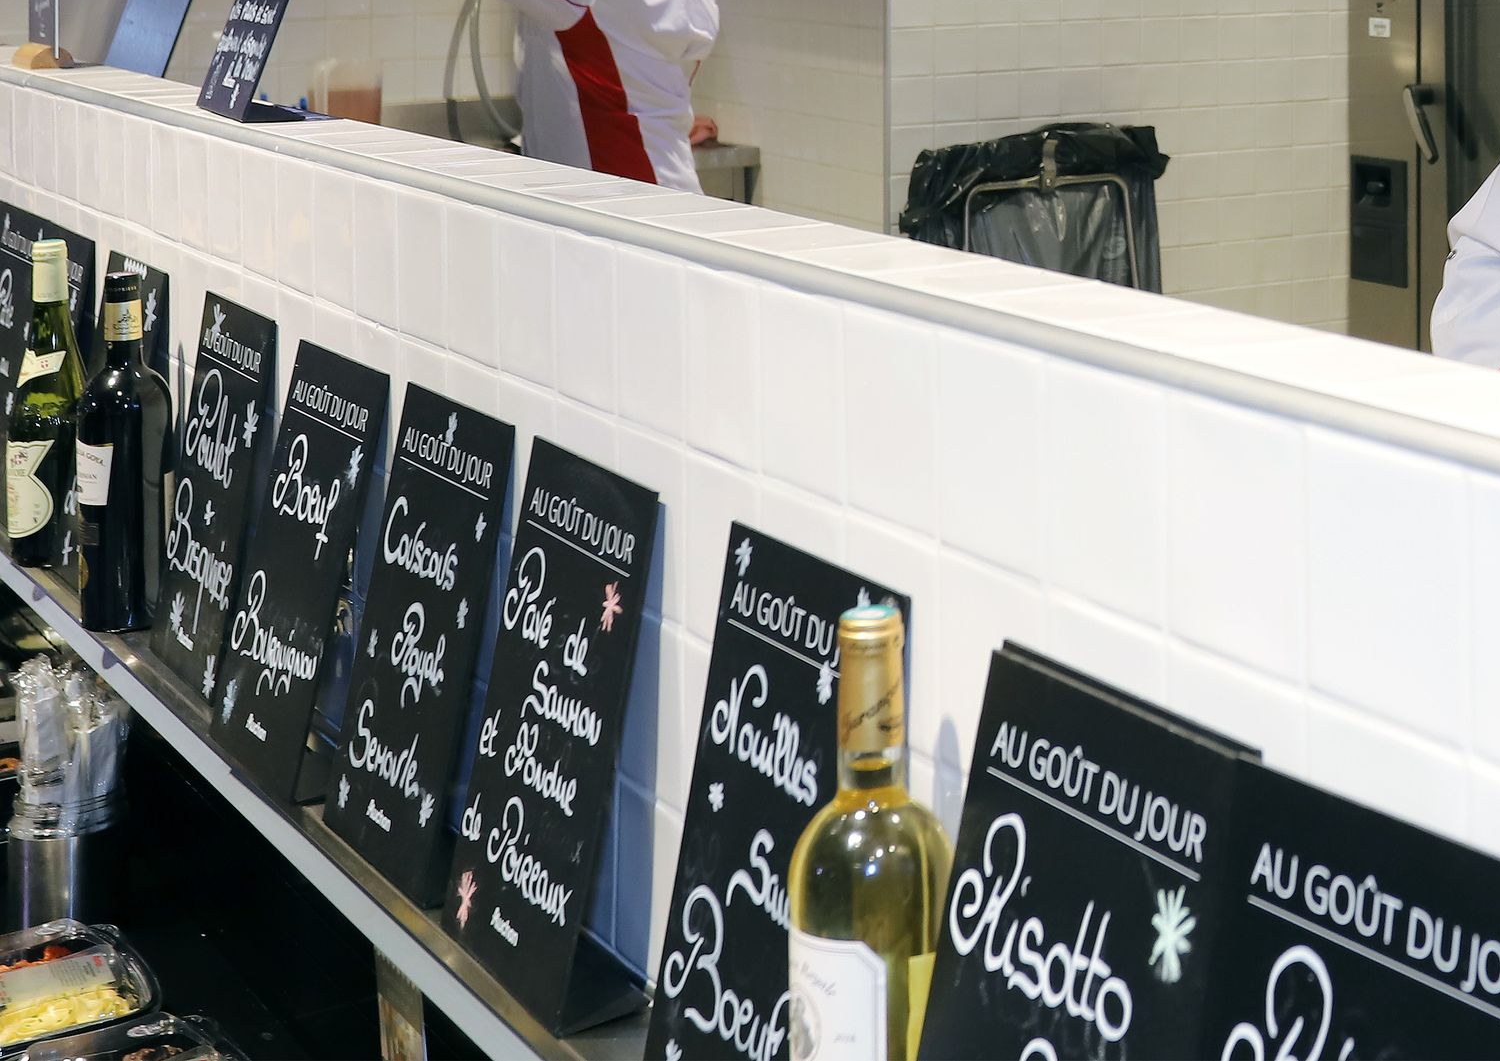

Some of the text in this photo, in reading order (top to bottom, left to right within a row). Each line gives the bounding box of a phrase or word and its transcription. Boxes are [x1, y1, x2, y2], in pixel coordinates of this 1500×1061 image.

[213, 331, 234, 359] GOÛT
[231, 341, 245, 365] DU
[240, 346, 262, 374] JOUR
[185, 368, 238, 490] Poulet
[292, 379, 369, 433] AU GOÛT DU JOUR
[402, 426, 494, 489] AU GOÛT DU JOUR
[383, 494, 459, 592] Couscous
[529, 486, 636, 565] AU GOÛT DU JOUR
[503, 545, 589, 677] Pavé de
[729, 580, 835, 656] AU GOÛT DU
[479, 708, 502, 758] et
[710, 663, 818, 808] Nouilles
[990, 720, 1208, 864] AU GOÛT DU JOUR
[461, 792, 575, 927] de Poireaux
[1250, 842, 1299, 901] AU
[1303, 874, 1404, 946] GOÛT
[1405, 905, 1462, 974] DU
[489, 905, 521, 948] Auchan
[948, 811, 1134, 1043] Risotto
